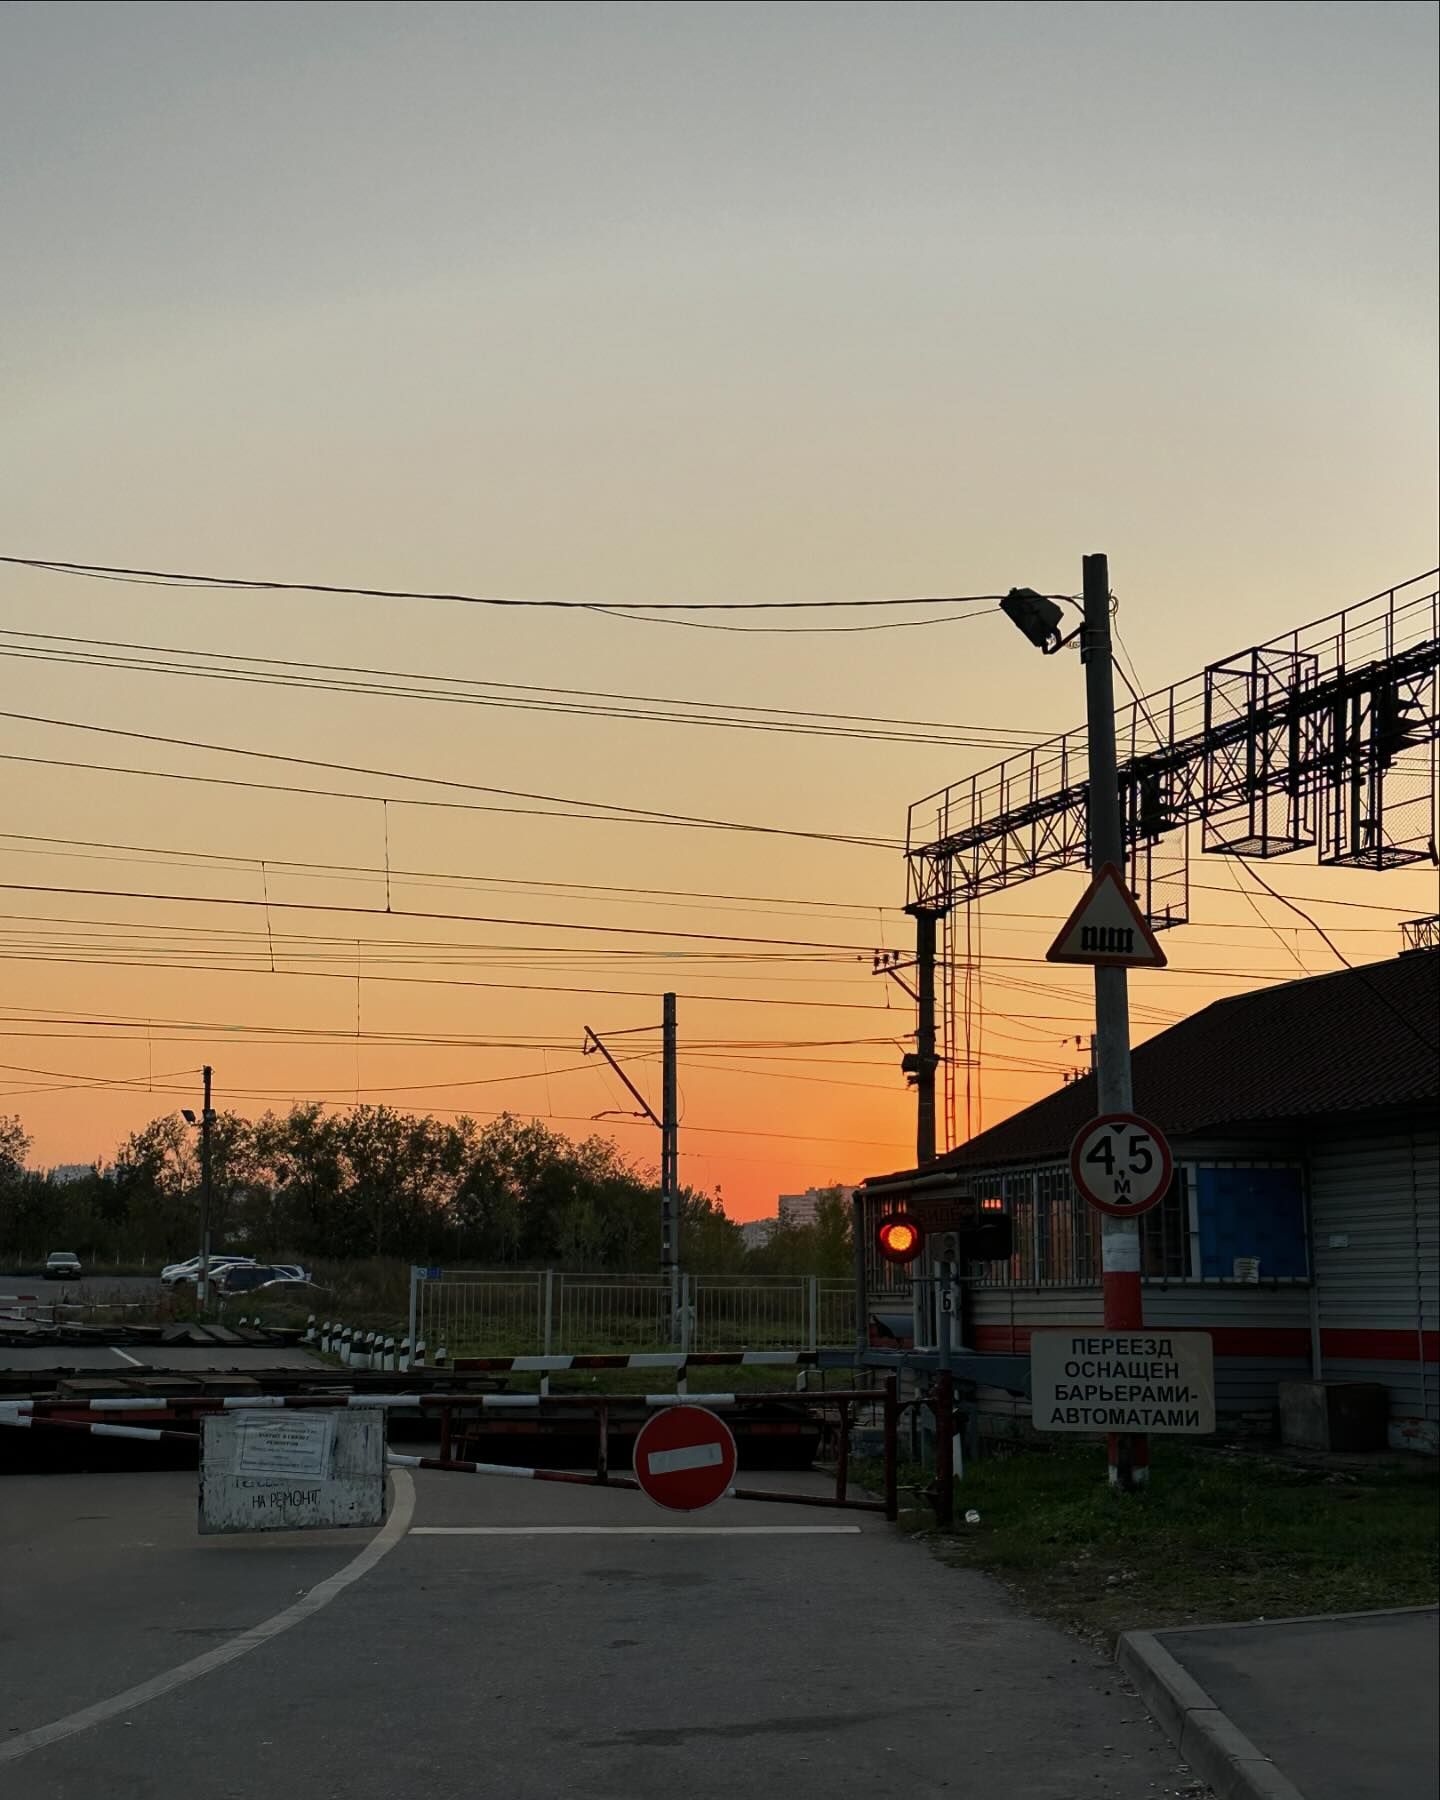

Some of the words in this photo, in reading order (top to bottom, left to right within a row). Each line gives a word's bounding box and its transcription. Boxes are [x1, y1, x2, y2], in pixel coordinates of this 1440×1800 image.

[1087, 1135, 1153, 1179] 4,5
[1072, 1338, 1173, 1358] ПЕРЕЕЗД
[1065, 1361, 1179, 1381] ОСНАЩЕН
[1055, 1384, 1198, 1402] БАРЬЕРАМИ-
[1050, 1407, 1199, 1426] АВТОМАТАМИ
